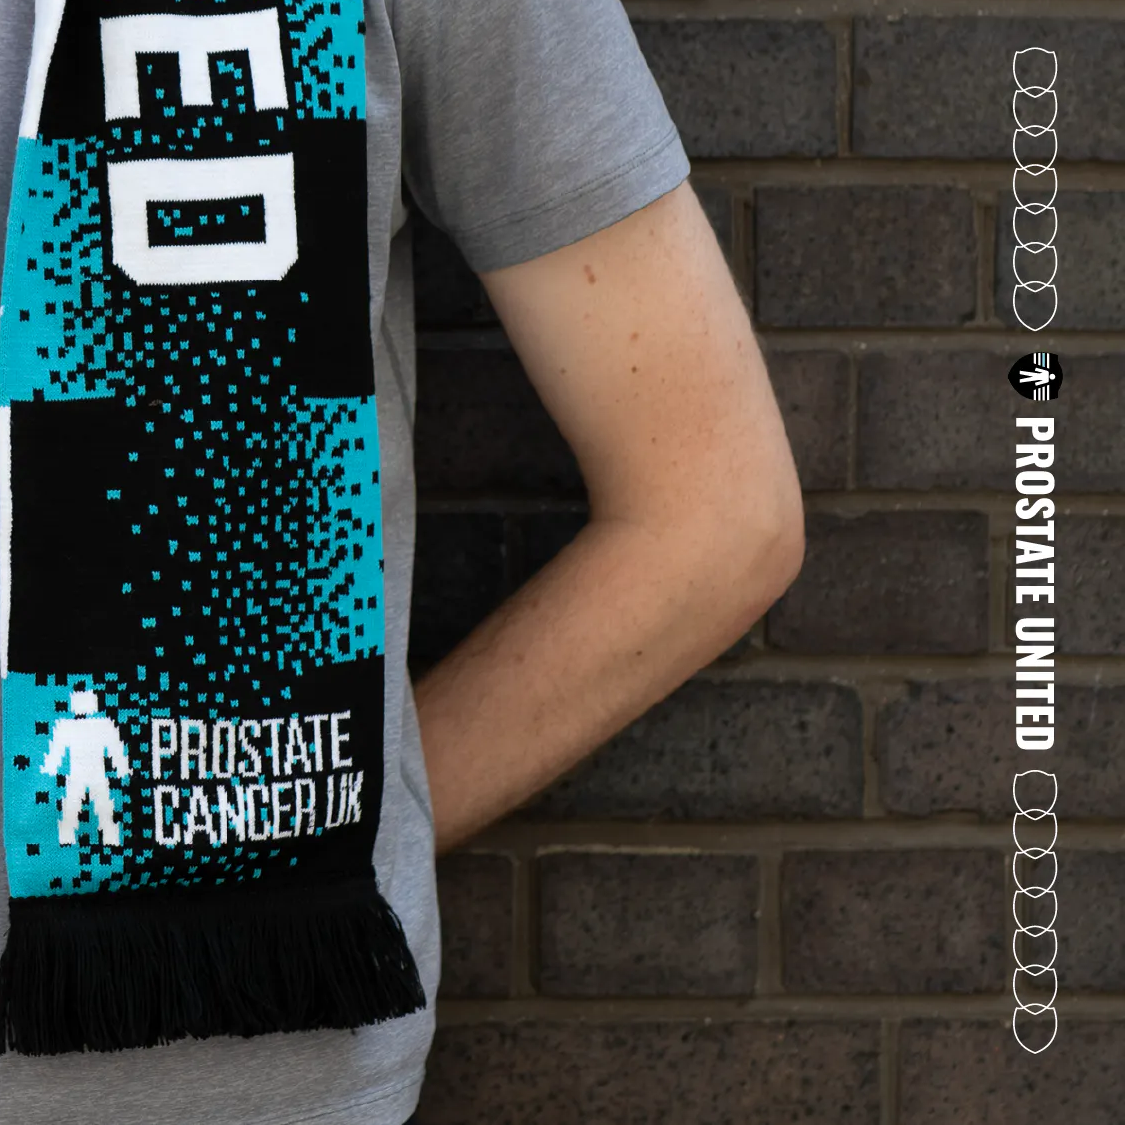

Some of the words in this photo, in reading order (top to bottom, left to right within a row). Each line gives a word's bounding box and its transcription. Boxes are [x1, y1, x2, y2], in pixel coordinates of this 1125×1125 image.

[151, 710, 353, 780] PROSTATE
[152, 777, 316, 846] CANCER
[324, 770, 365, 830] UK
